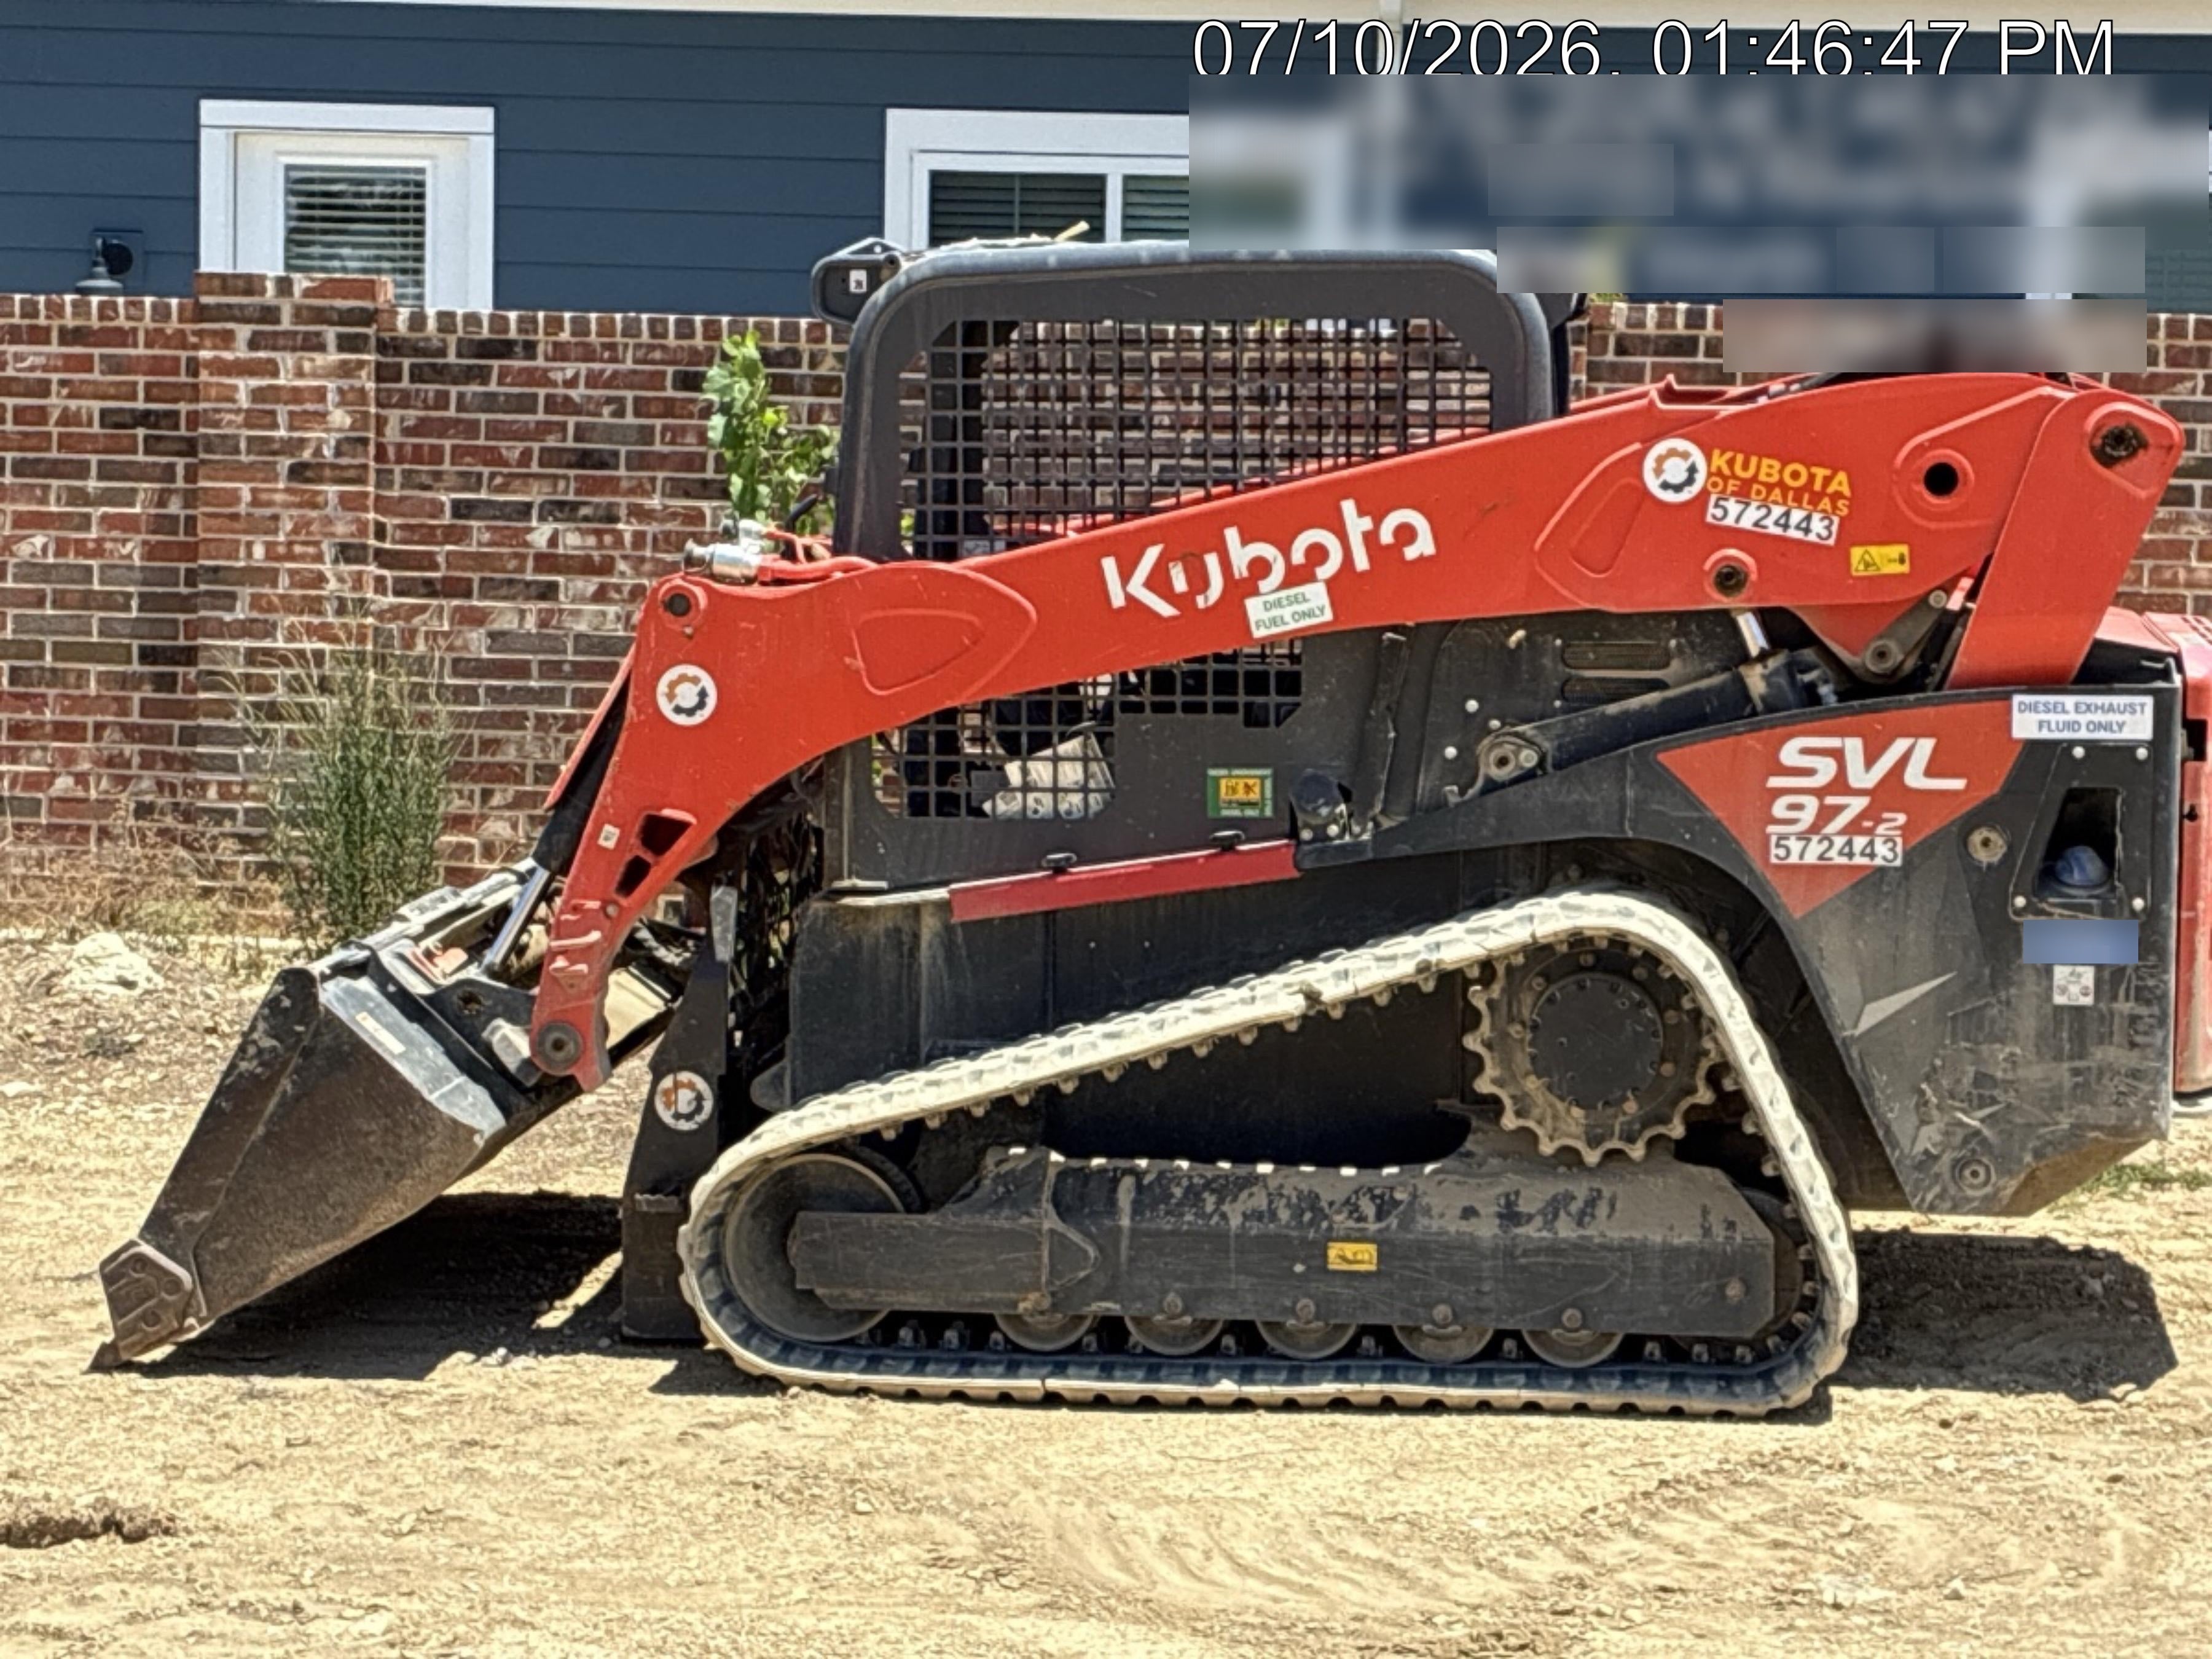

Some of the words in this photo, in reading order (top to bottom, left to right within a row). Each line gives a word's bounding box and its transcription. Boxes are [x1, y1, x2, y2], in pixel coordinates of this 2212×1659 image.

[1709, 448, 1851, 498] KUBOTA
[1706, 476, 1739, 495] OF
[1750, 484, 1851, 517] DALLAS
[1710, 497, 1835, 541] 572443
[1100, 498, 1437, 618] Kubota
[1255, 614, 1290, 631] FUEL
[1291, 605, 1325, 623] ONLY
[1263, 592, 1310, 611] DIESEL
[2017, 700, 2069, 715] DIESEL
[2074, 701, 2147, 715] EXHAUST
[2037, 720, 2082, 733] FLUID
[2085, 720, 2127, 734] ONLY
[1766, 736, 1967, 790] SVL
[1765, 794, 1907, 836] 97-2
[1773, 836, 1900, 864] 572443
